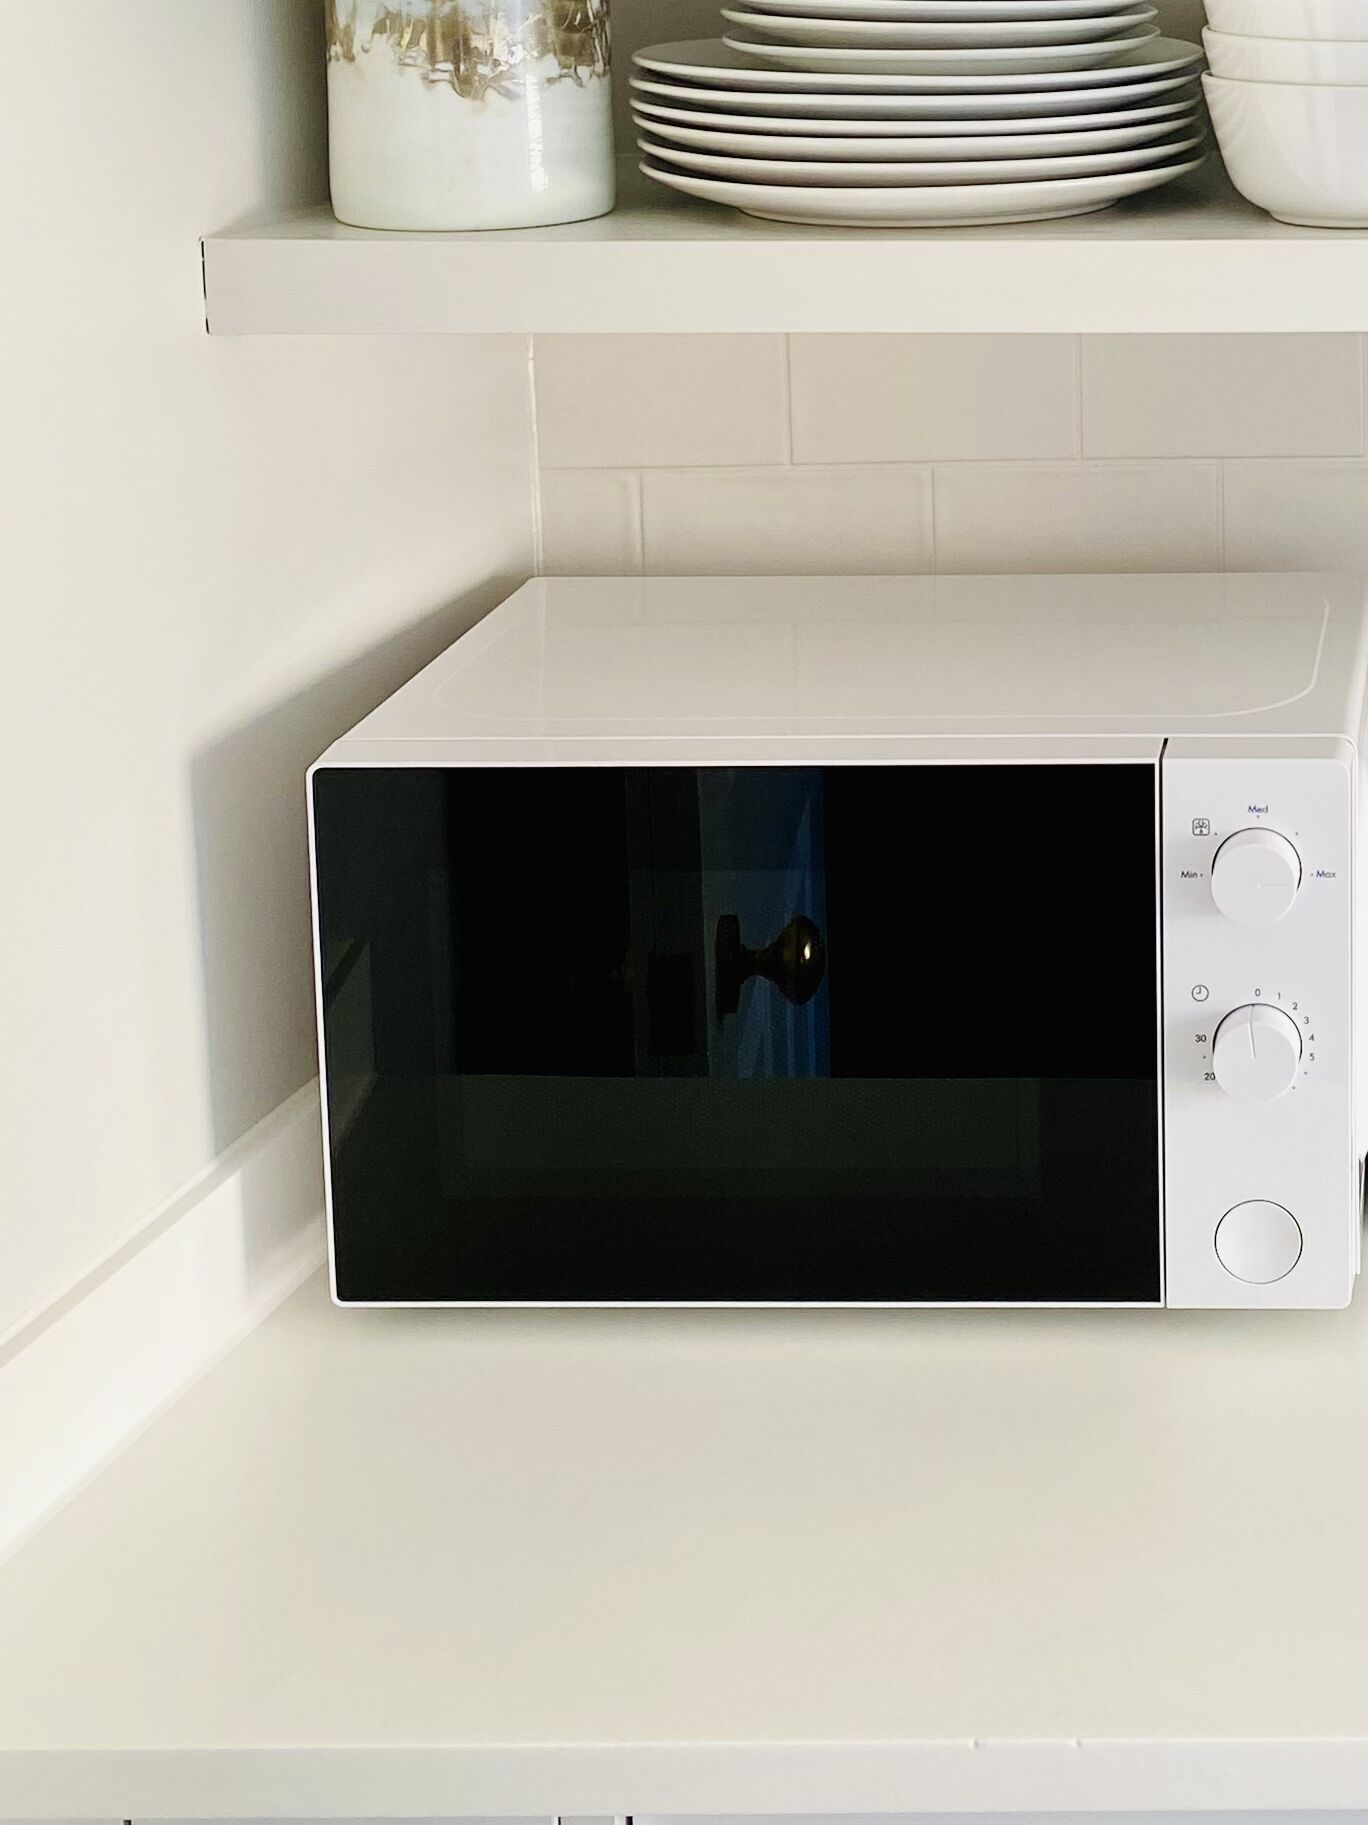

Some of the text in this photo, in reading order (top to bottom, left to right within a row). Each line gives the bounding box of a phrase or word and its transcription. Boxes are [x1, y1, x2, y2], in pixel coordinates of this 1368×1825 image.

[1247, 805, 1268, 814] Med
[1180, 870, 1198, 879] Min
[1316, 870, 1336, 879] Max
[1254, 988, 1261, 997] 0
[1277, 991, 1282, 1000] 1
[1292, 1002, 1298, 1011] 2
[1303, 1016, 1310, 1025] 3
[1195, 1034, 1207, 1043] 30
[1308, 1033, 1315, 1042] 4
[1308, 1052, 1315, 1061] 5
[1204, 1072, 1216, 1081] 20
